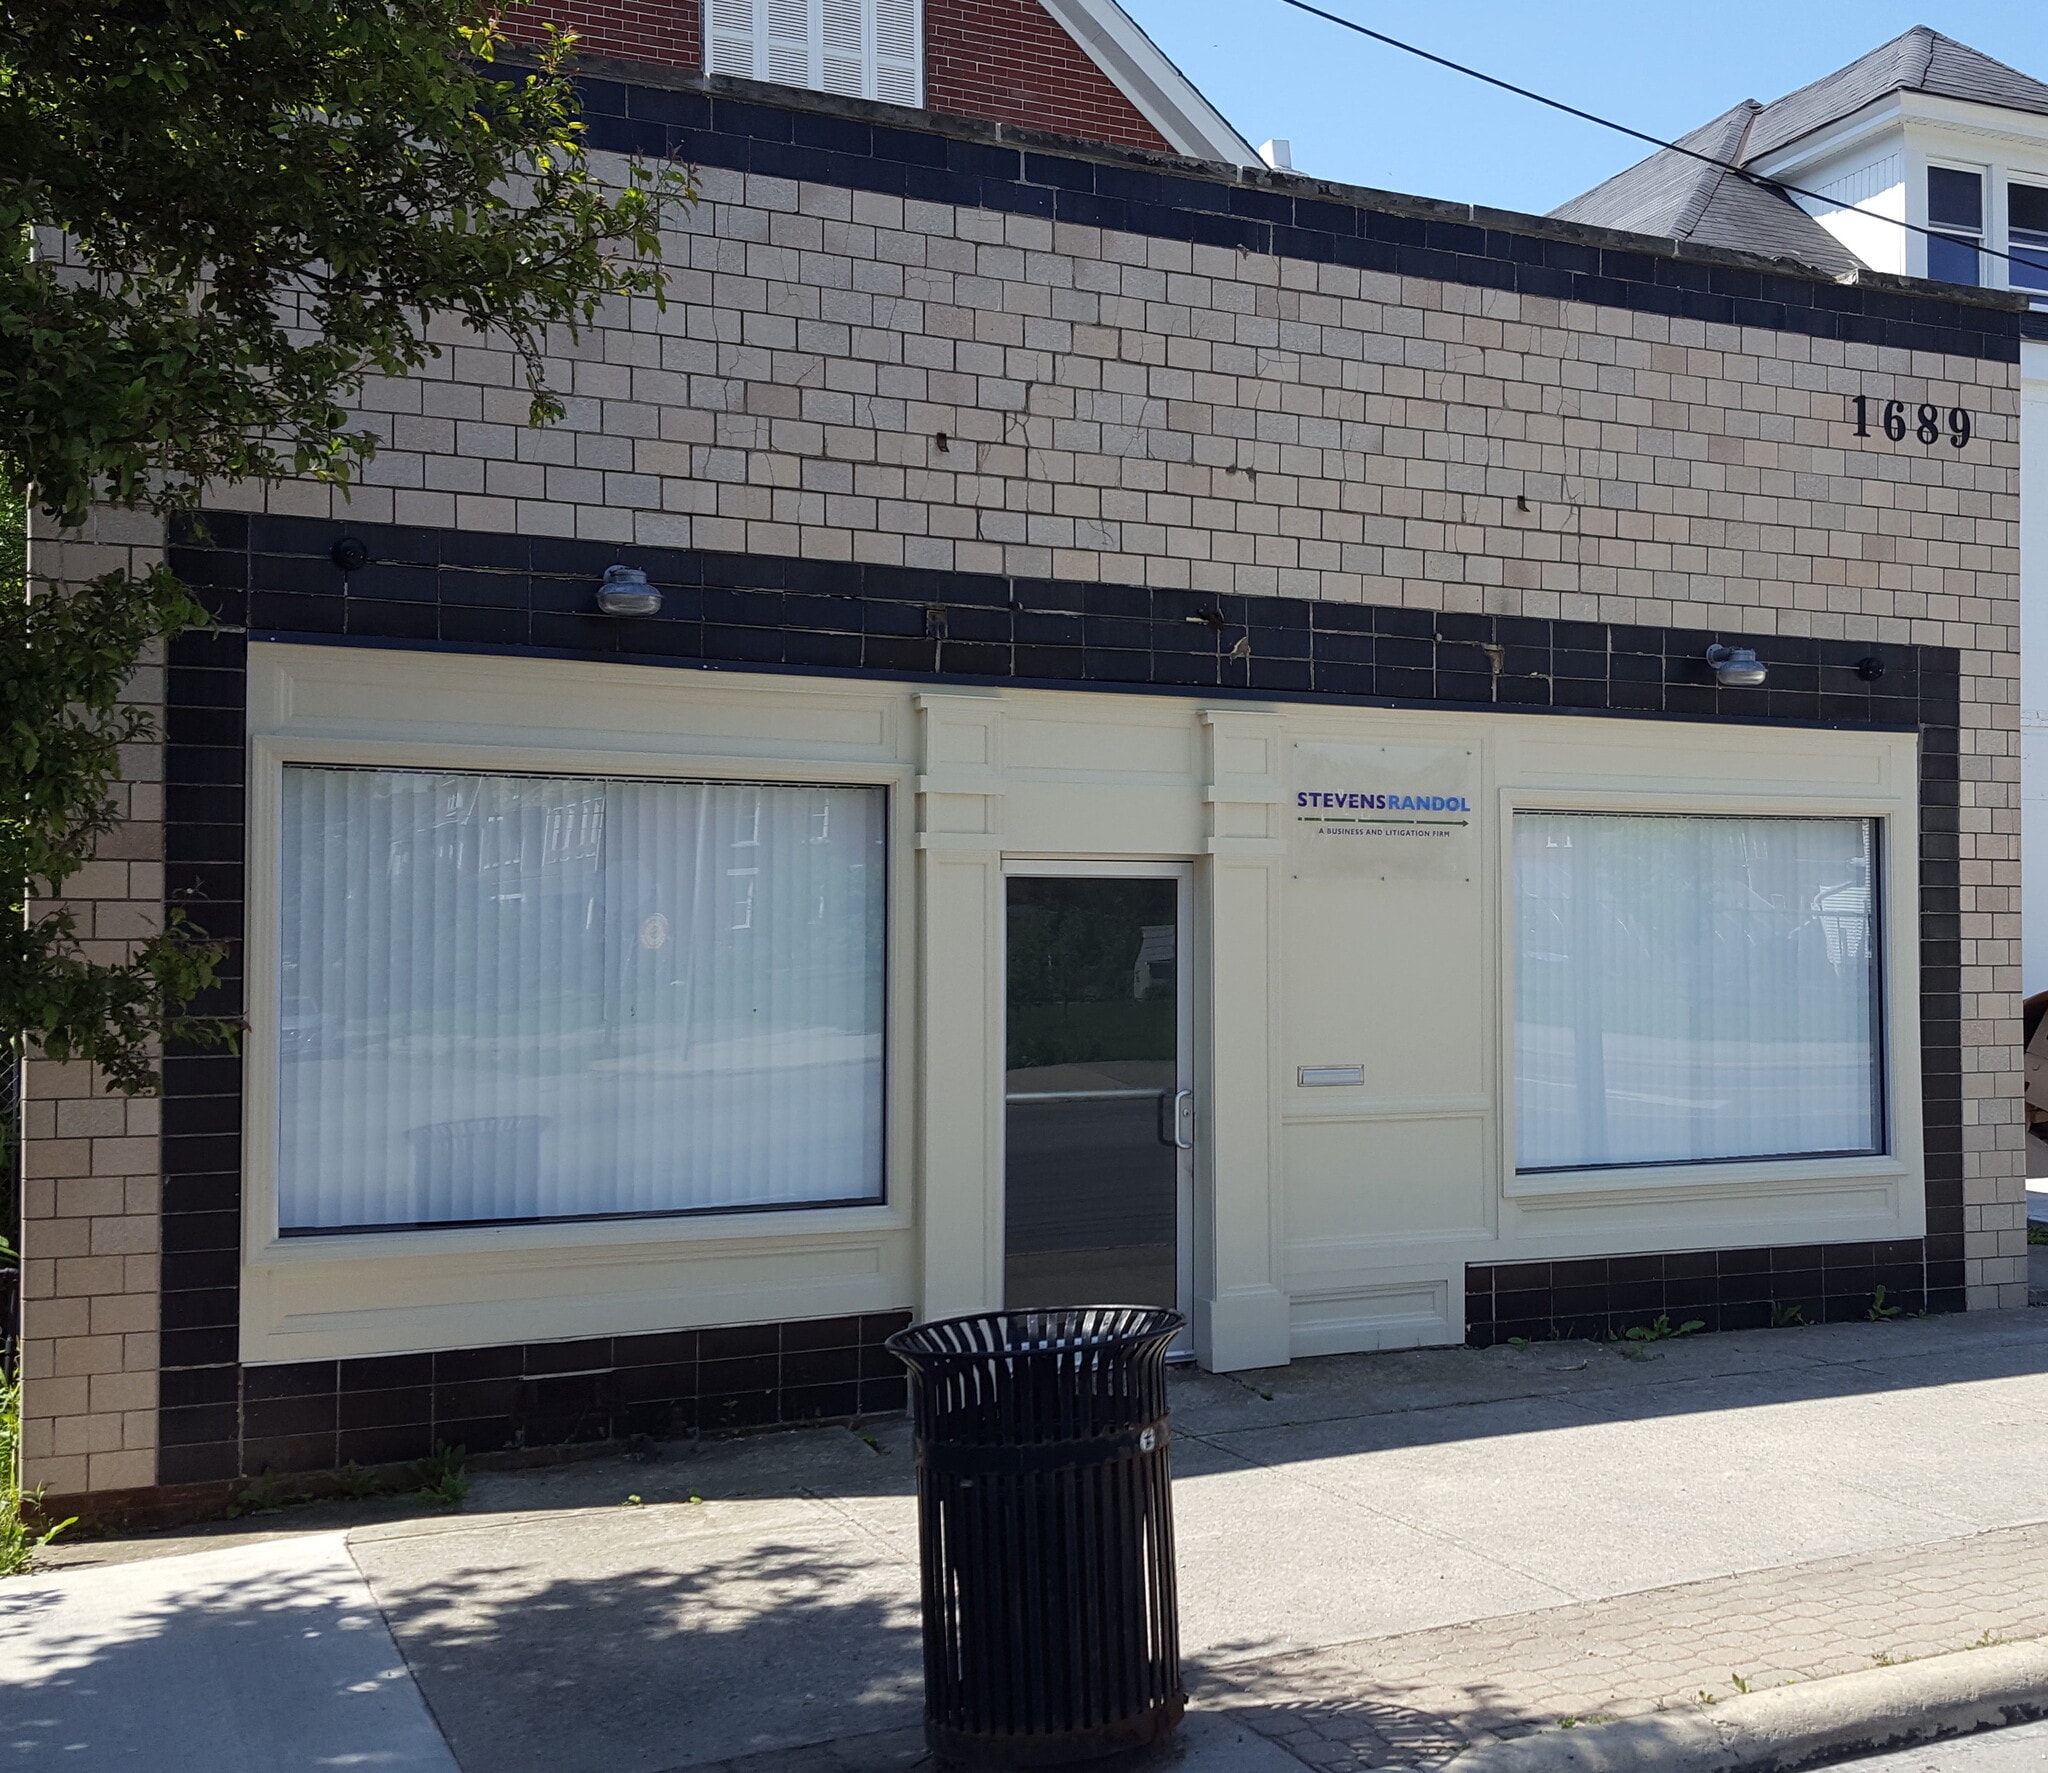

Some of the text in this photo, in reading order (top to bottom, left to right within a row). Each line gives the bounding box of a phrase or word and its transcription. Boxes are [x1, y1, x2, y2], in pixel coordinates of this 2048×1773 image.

[1851, 395, 1971, 448] 1689
[1327, 828, 1364, 836] BUSINESS
[1432, 830, 1450, 838] FIRM
